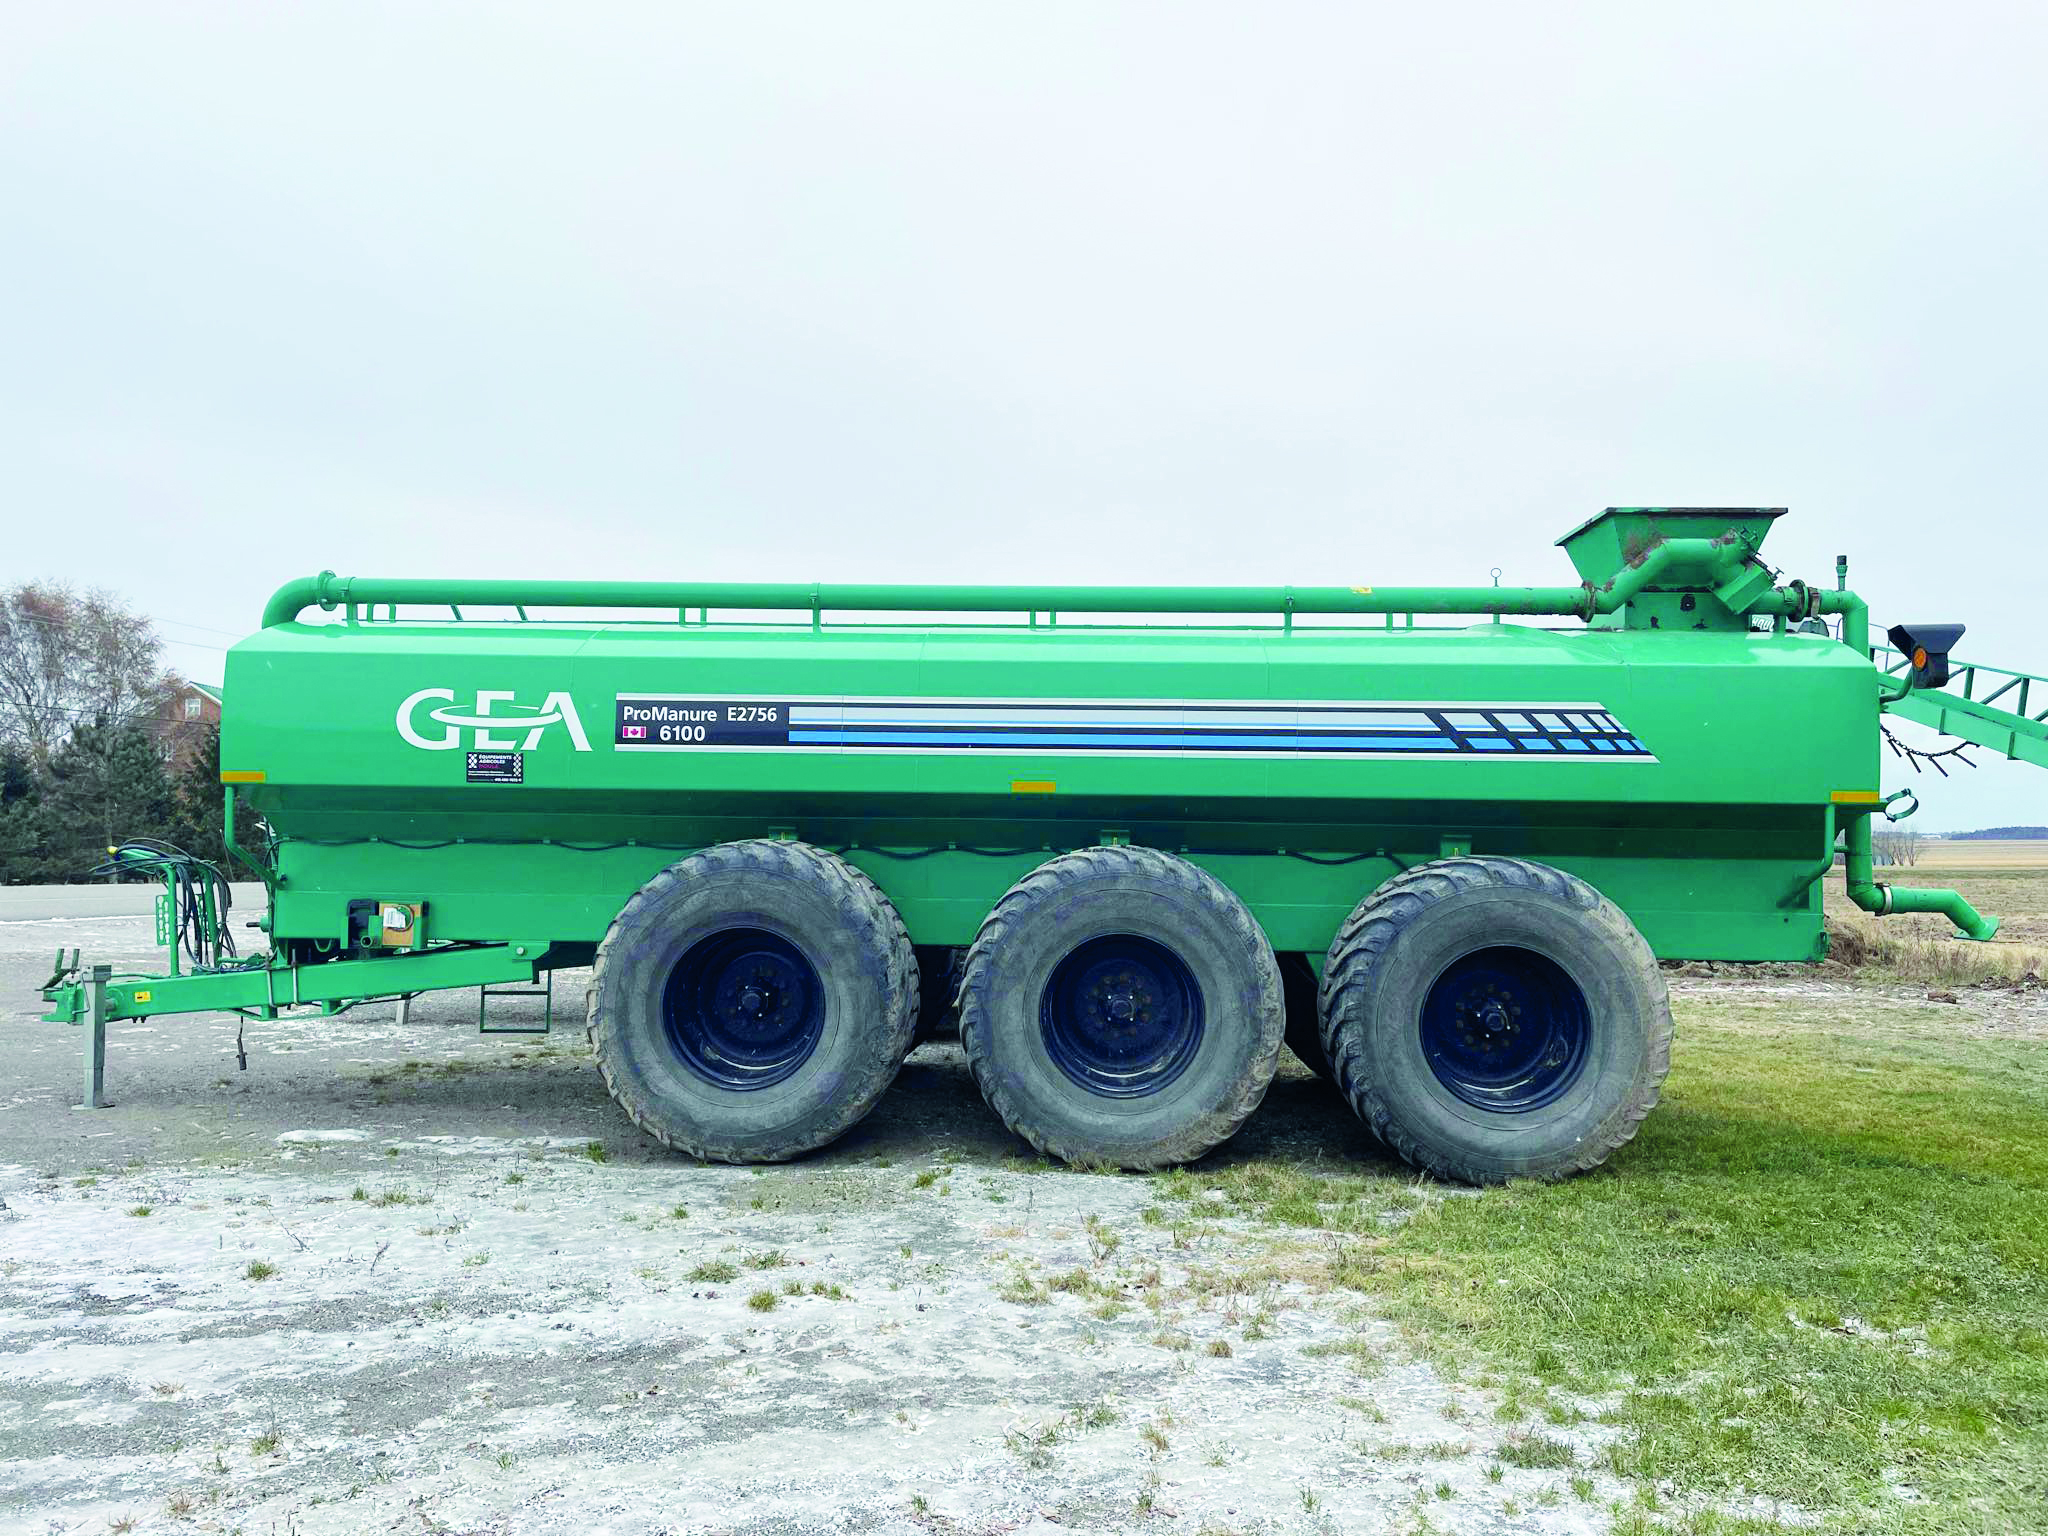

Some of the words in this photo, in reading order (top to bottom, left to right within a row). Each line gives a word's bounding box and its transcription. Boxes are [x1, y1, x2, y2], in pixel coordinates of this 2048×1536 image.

[396, 688, 592, 752] GEA
[623, 706, 718, 722] ProManure
[727, 706, 778, 722] E2756
[659, 725, 706, 742] 6100
